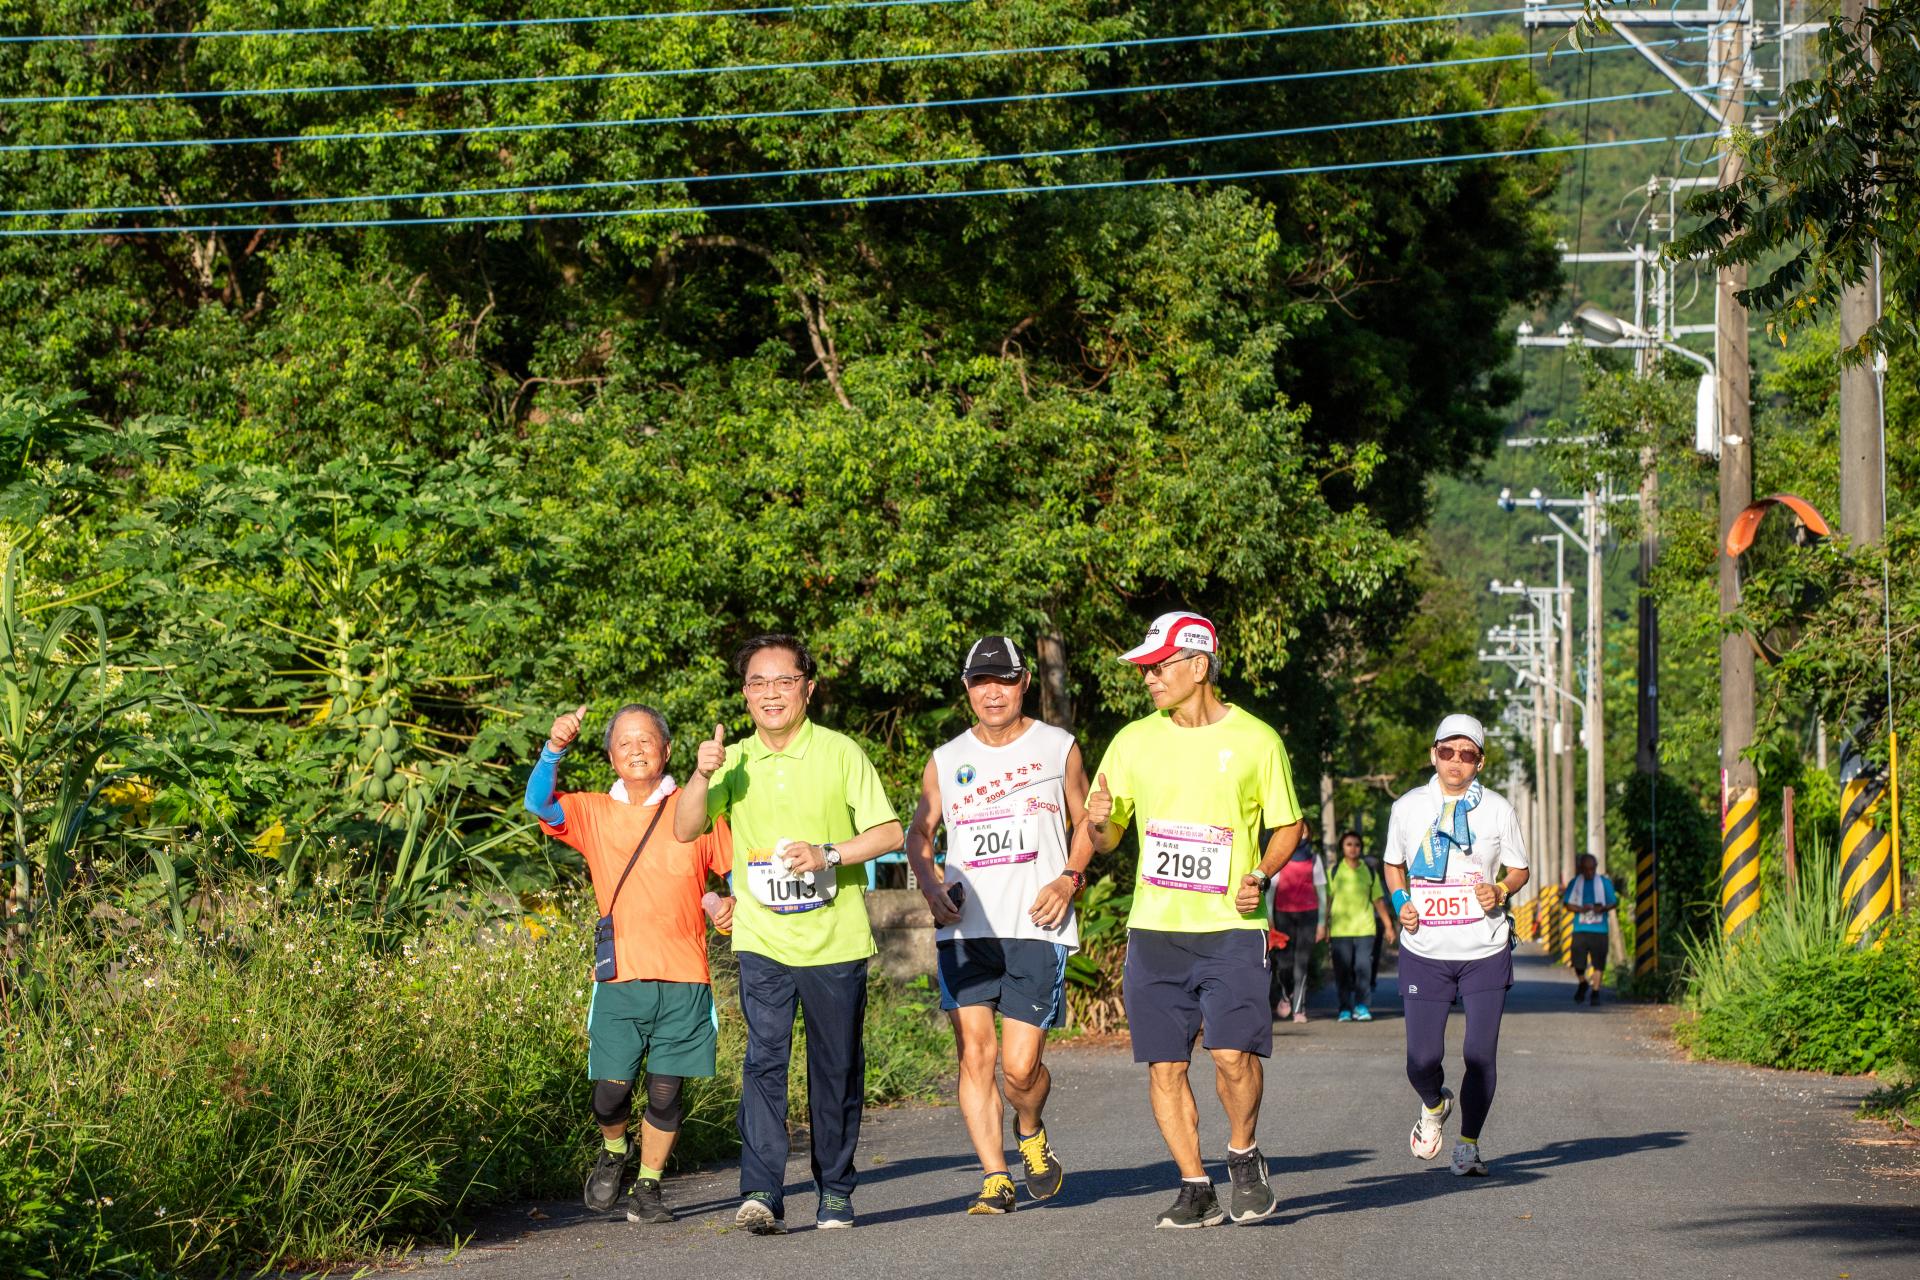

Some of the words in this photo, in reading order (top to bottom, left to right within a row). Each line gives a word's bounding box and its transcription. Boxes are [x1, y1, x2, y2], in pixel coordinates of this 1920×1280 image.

[985, 789, 1006, 804] 2006
[973, 829, 1024, 857] 2041
[1157, 851, 1212, 880] 2198
[1425, 897, 1469, 917] 2051
